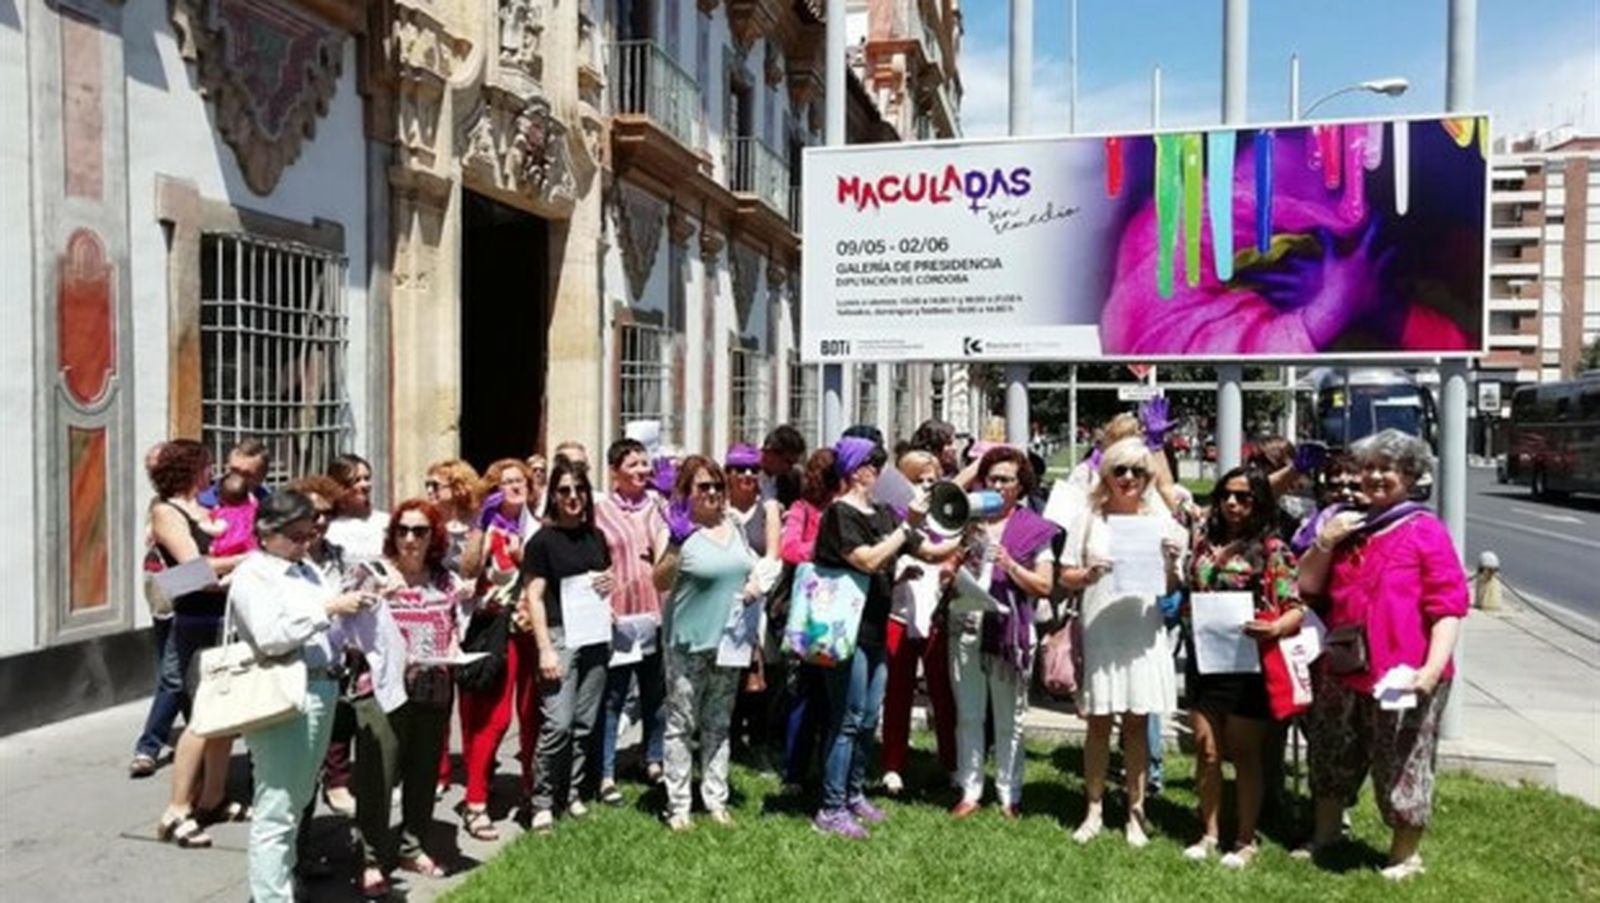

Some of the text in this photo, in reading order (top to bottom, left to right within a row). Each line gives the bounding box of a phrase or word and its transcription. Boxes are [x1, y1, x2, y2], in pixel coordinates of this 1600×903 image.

[836, 164, 1032, 212] MACULADAS
[835, 239, 887, 257] 09/05
[898, 236, 950, 254] 02/06
[835, 257, 1003, 275] GALERÍA DE PRESIDENCIA
[835, 275, 898, 288] DIPUTACIÓN
[900, 276, 914, 286] DE
